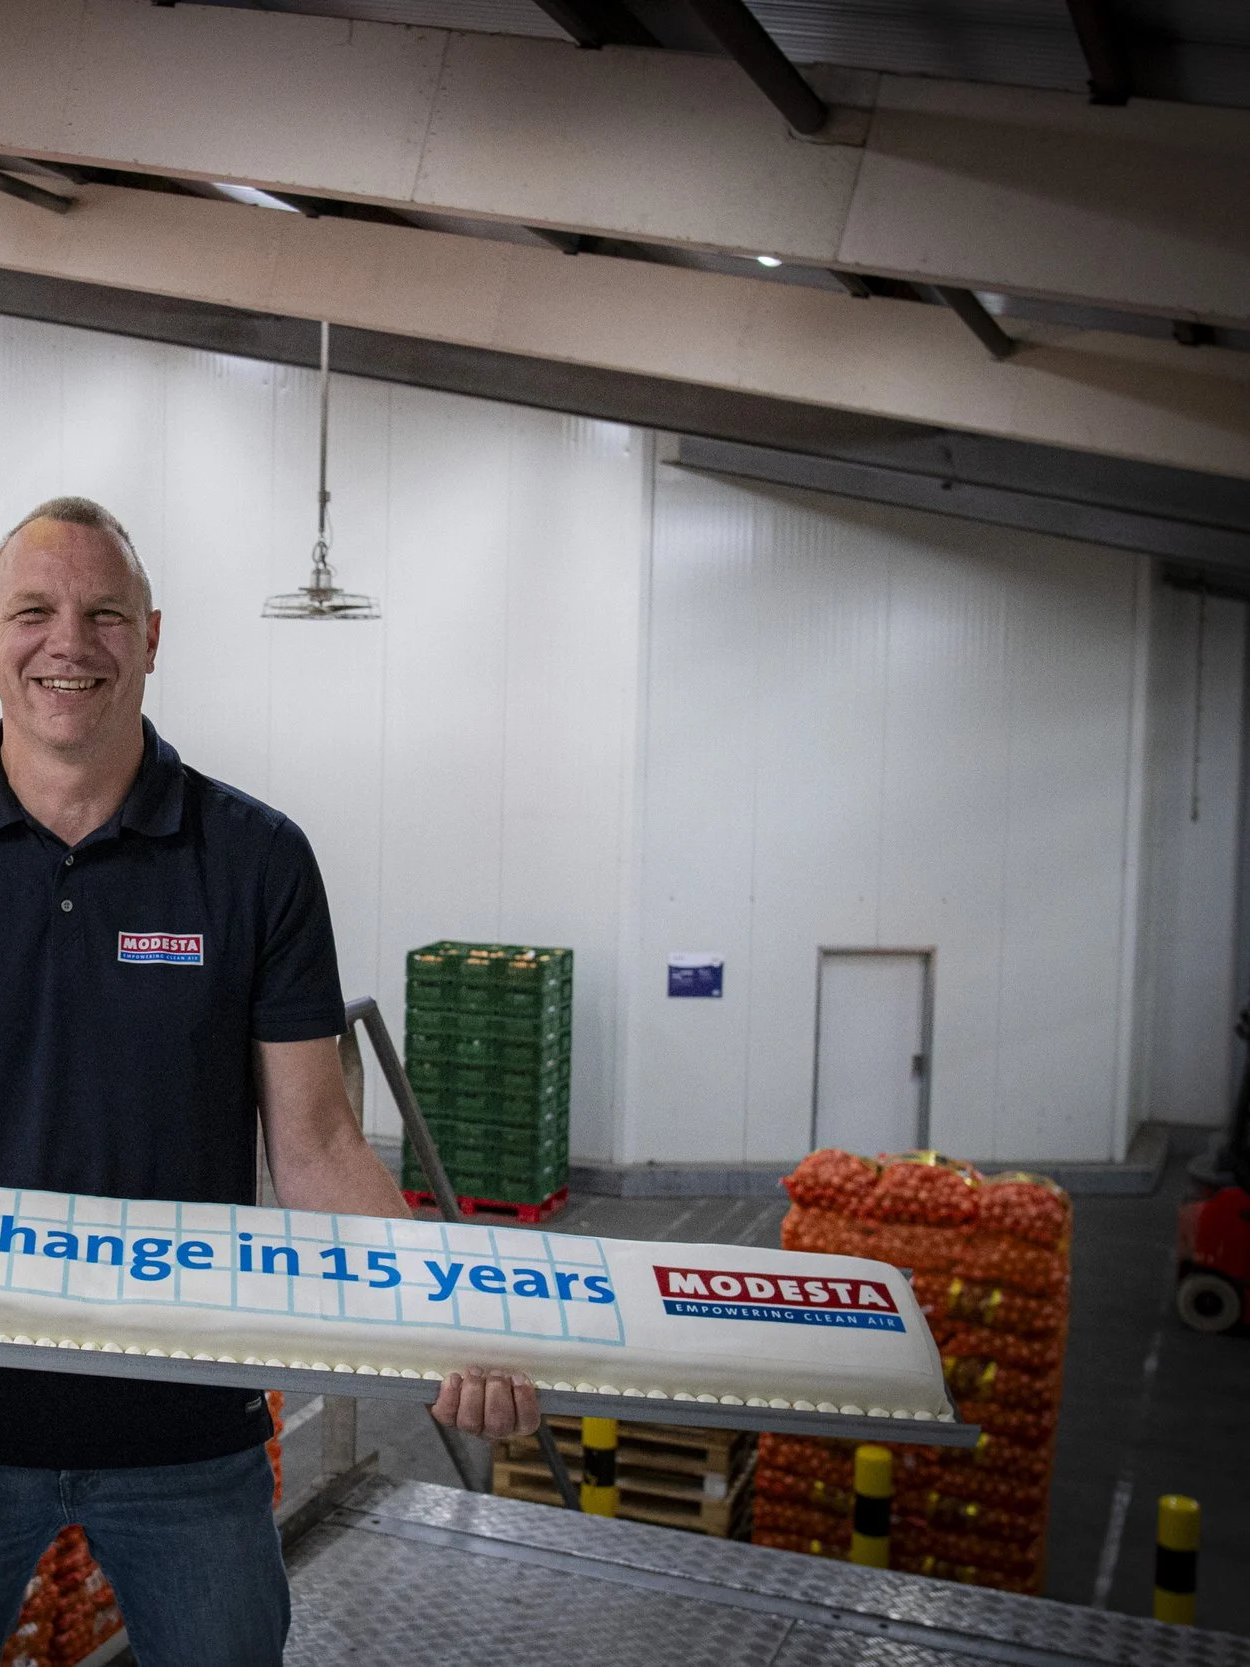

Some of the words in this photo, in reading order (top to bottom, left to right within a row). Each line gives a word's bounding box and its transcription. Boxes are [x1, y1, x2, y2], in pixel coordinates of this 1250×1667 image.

[123, 938, 198, 951] MODESTA
[237, 1232, 301, 1277] in
[320, 1247, 402, 1289] 15
[423, 1259, 617, 1305] years
[668, 1271, 891, 1308] MODESTA
[676, 1303, 795, 1320] EMPOWERING
[804, 1312, 858, 1325] CLEAN
[867, 1316, 897, 1328] AIR
